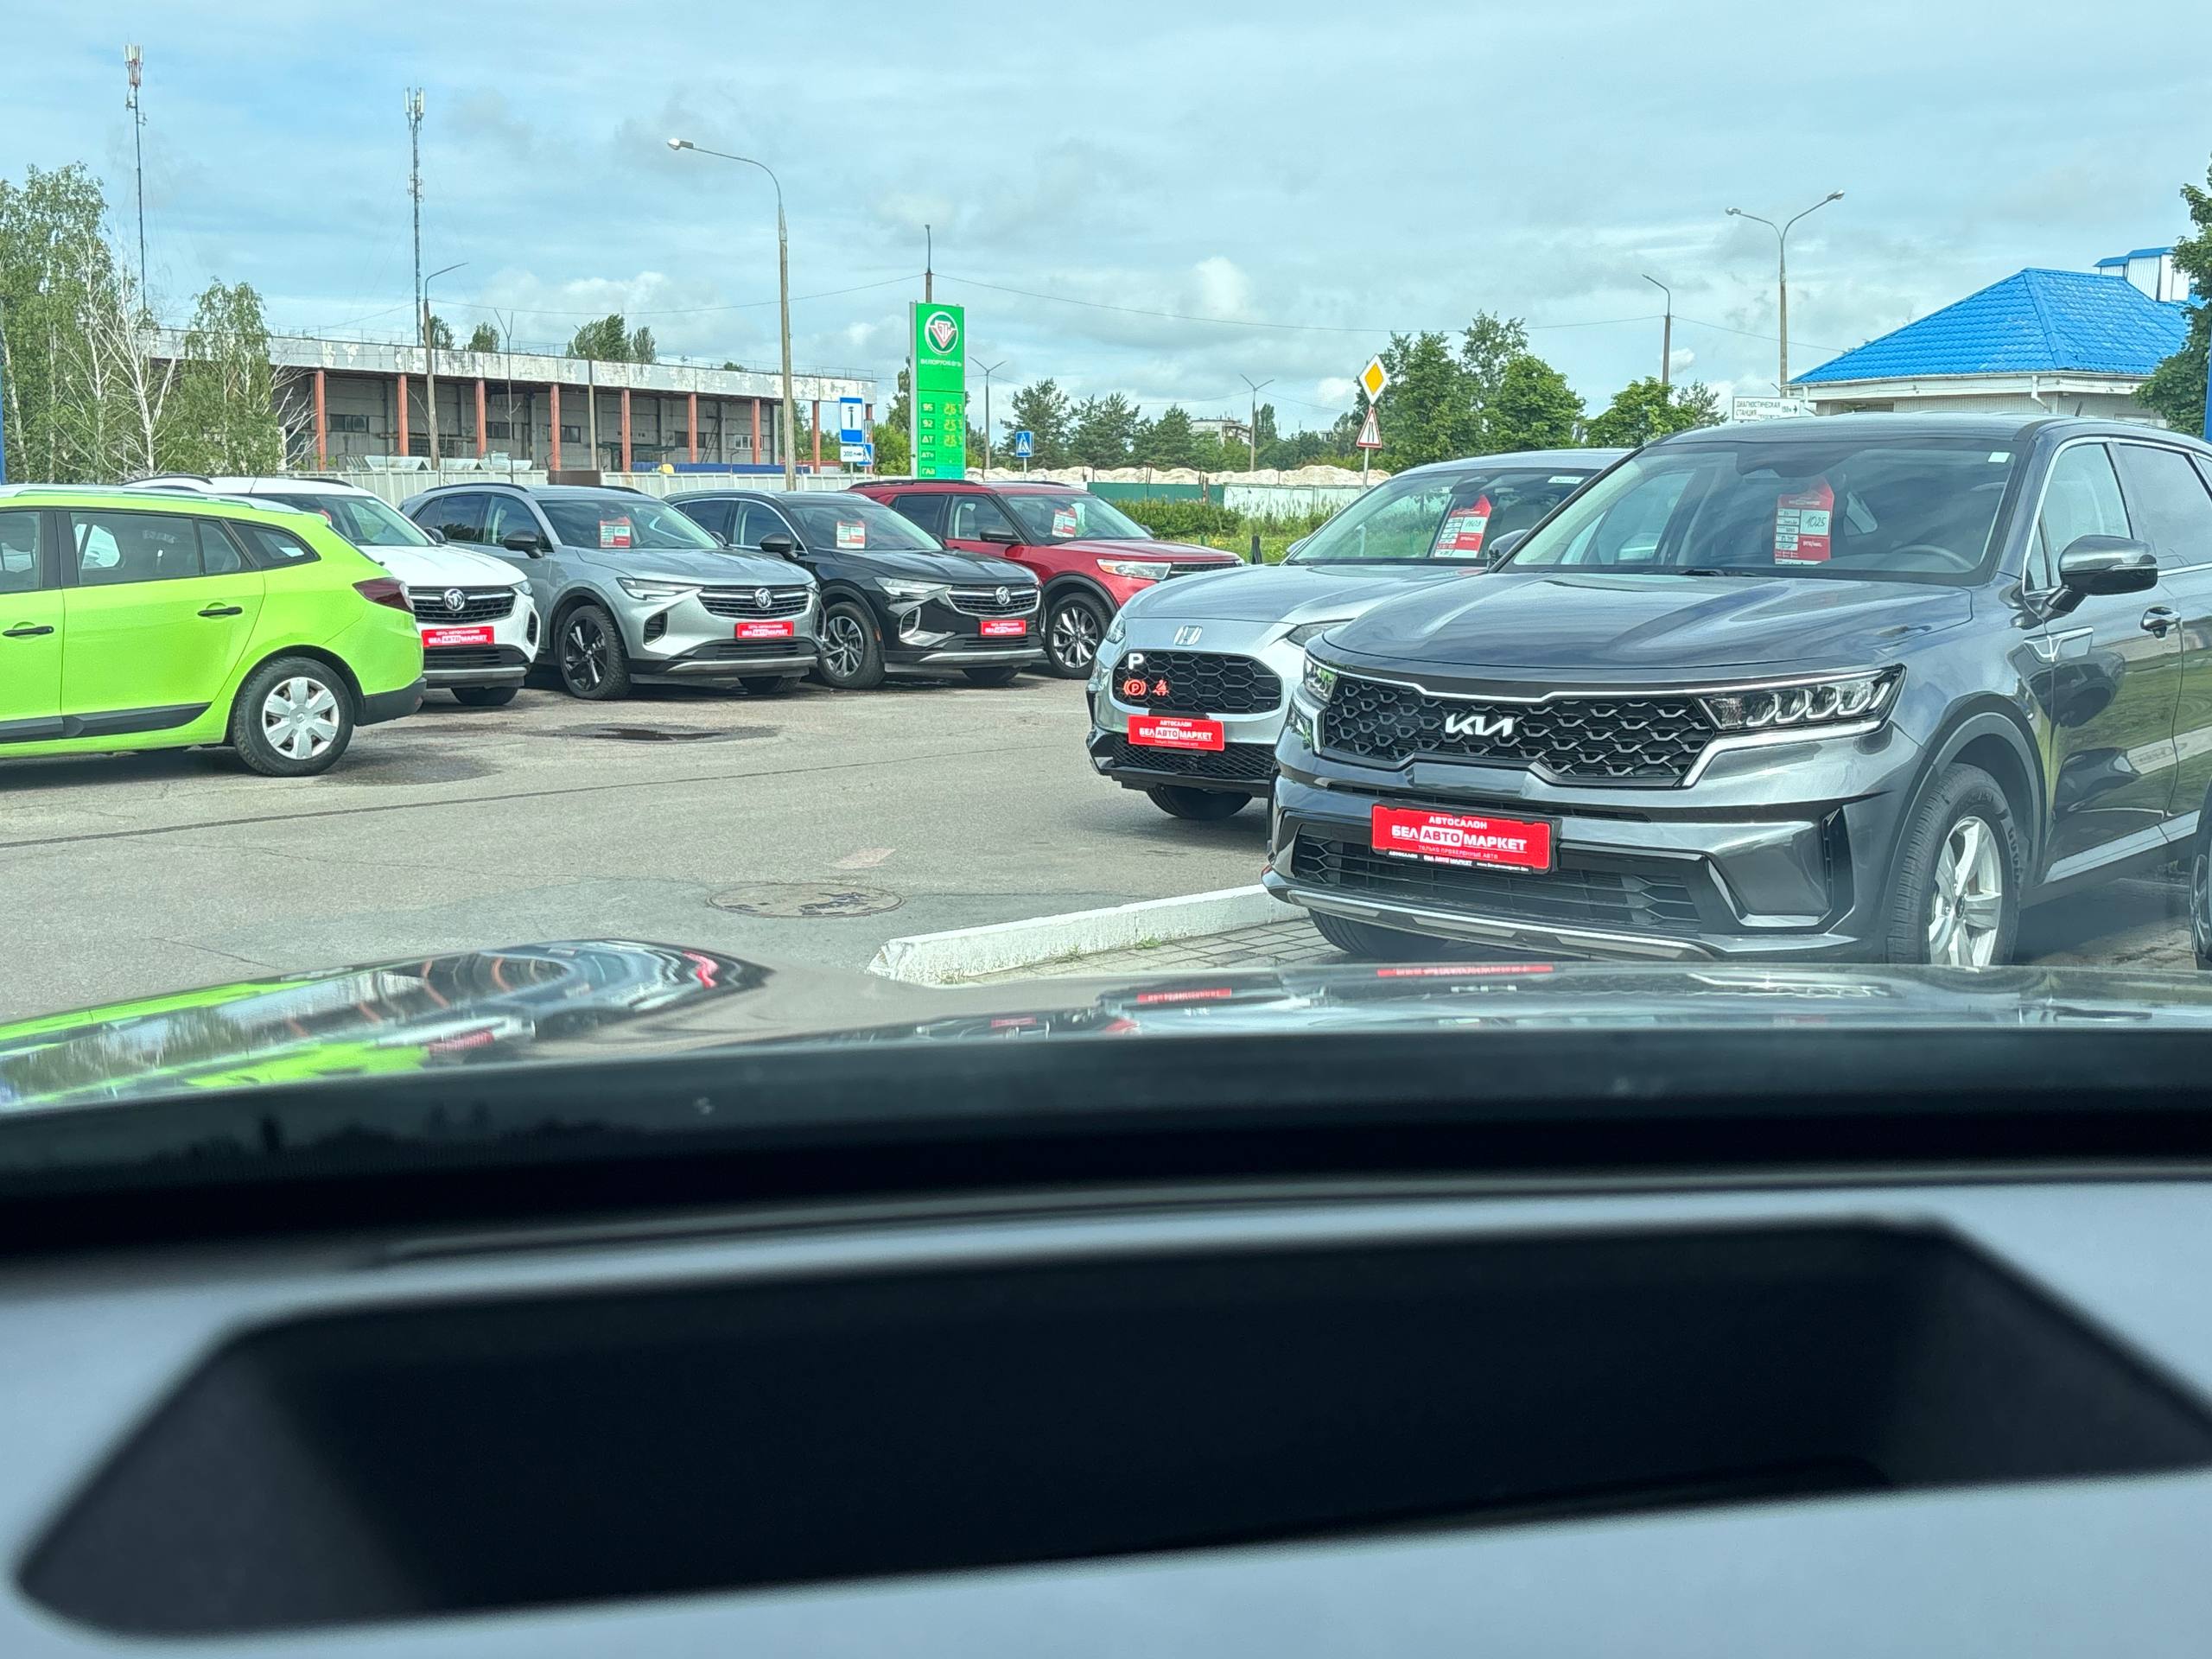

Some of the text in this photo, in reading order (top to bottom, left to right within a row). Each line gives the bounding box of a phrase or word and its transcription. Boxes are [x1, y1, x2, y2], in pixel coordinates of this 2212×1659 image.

[922, 403, 933, 411] 95
[922, 419, 933, 428] 92
[1806, 516, 1827, 528] 1025
[1445, 713, 1514, 737] KIA
[1428, 816, 1487, 830] АВТОСАЛОН
[1418, 845, 1440, 854] ТОЛЬКО
[1463, 836, 1528, 852] МАРКЕТ
